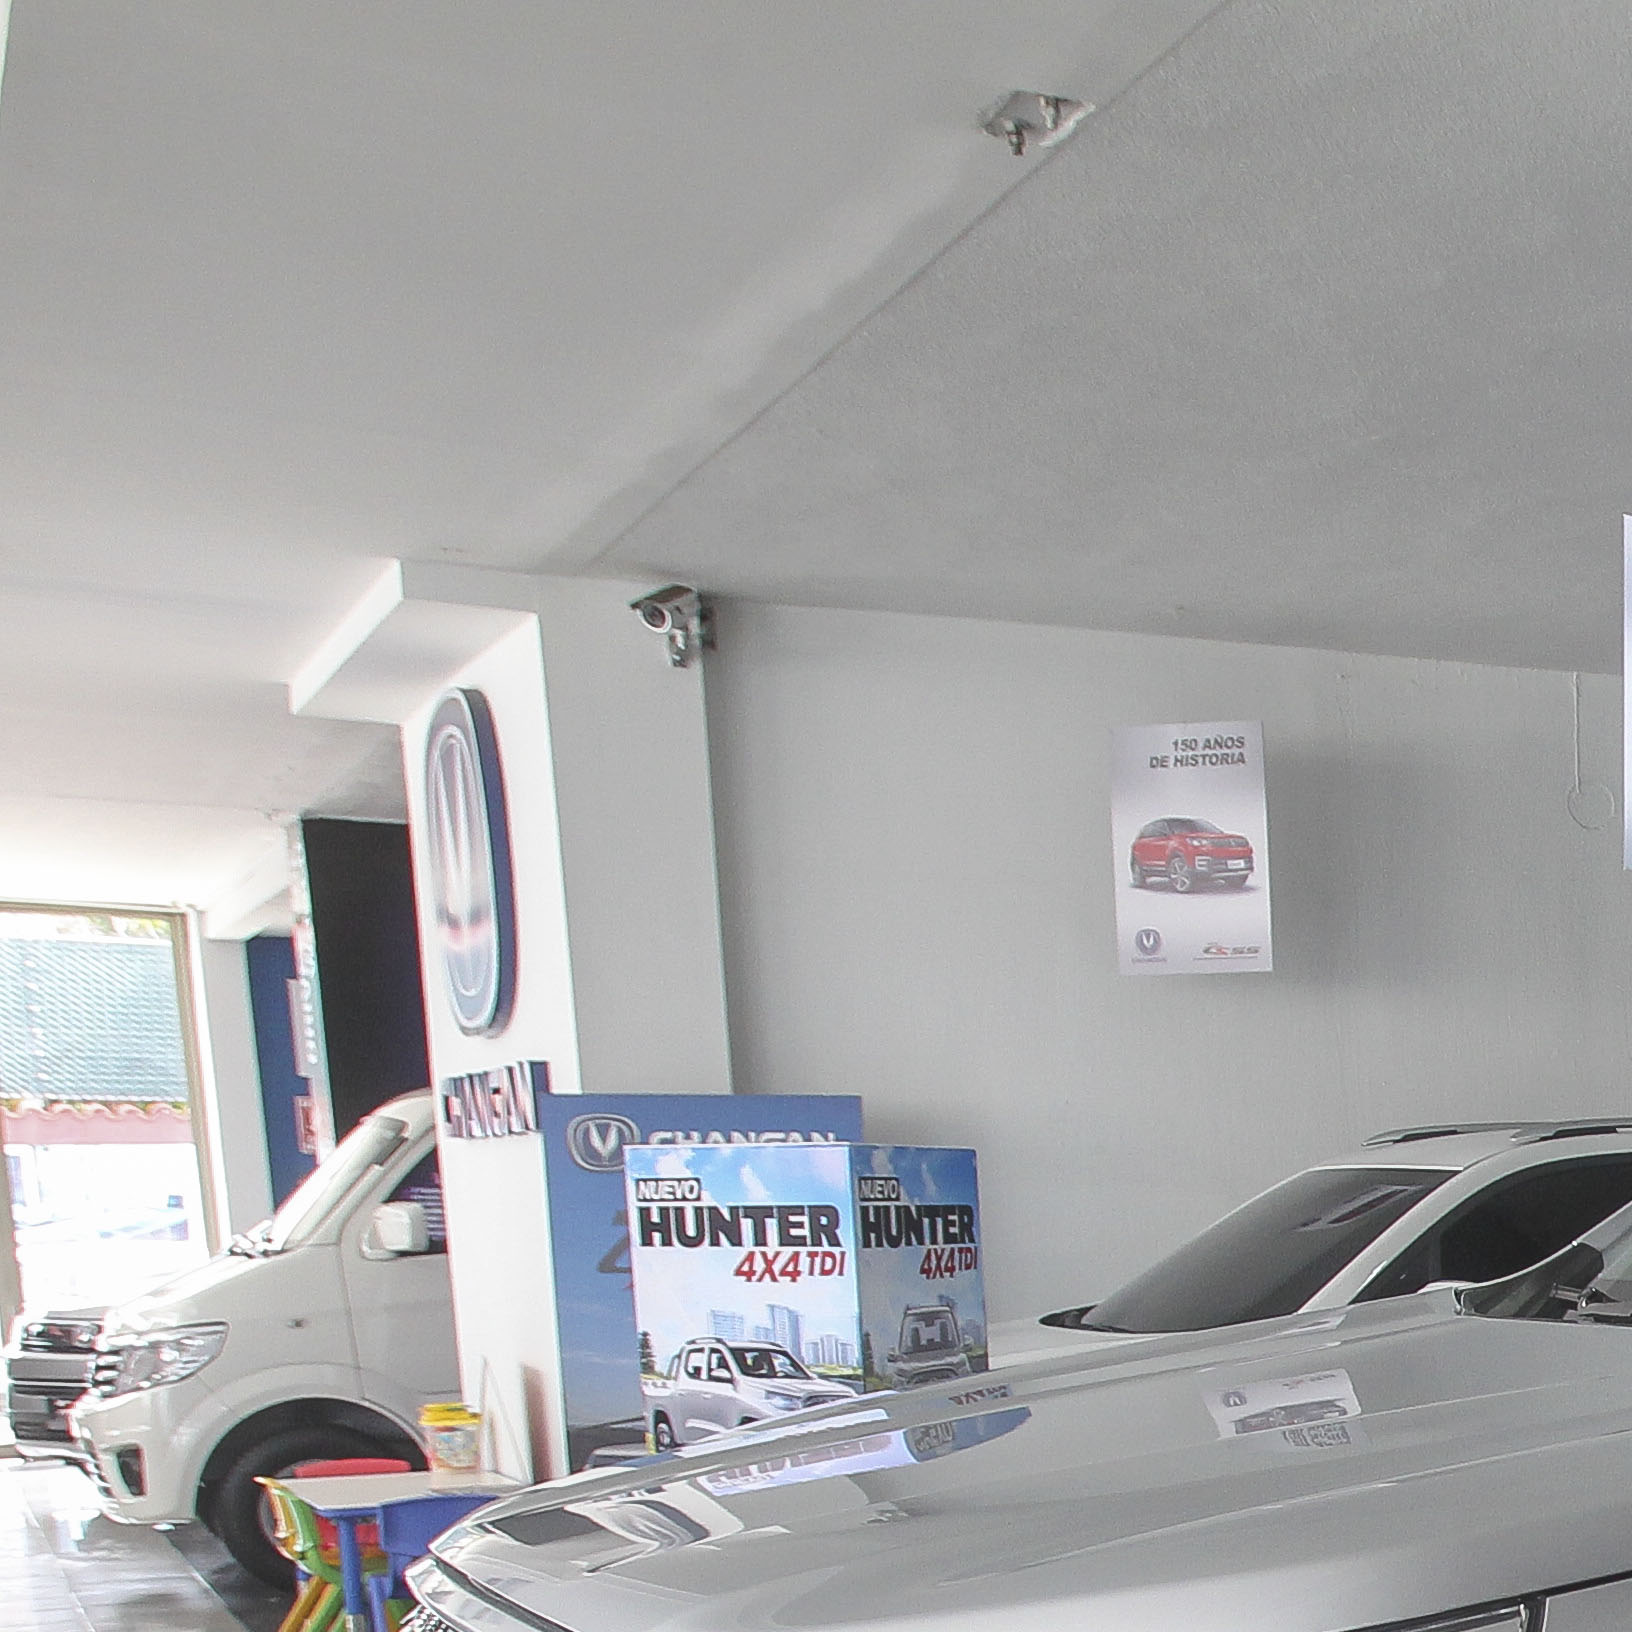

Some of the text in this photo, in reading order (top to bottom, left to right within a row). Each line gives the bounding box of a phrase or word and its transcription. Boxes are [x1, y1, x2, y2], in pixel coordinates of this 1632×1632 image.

[1171, 735, 1245, 752] 150 AÑOS
[1150, 751, 1246, 769] DE HISTORIA
[637, 1179, 699, 1200] NUEVO
[860, 1179, 899, 1199] NUEVO
[639, 1204, 842, 1248] HUNTER
[860, 1205, 976, 1248] HUNTER
[734, 1250, 847, 1283] 4X4 TDI
[920, 1246, 978, 1279] 4X4 TDI
